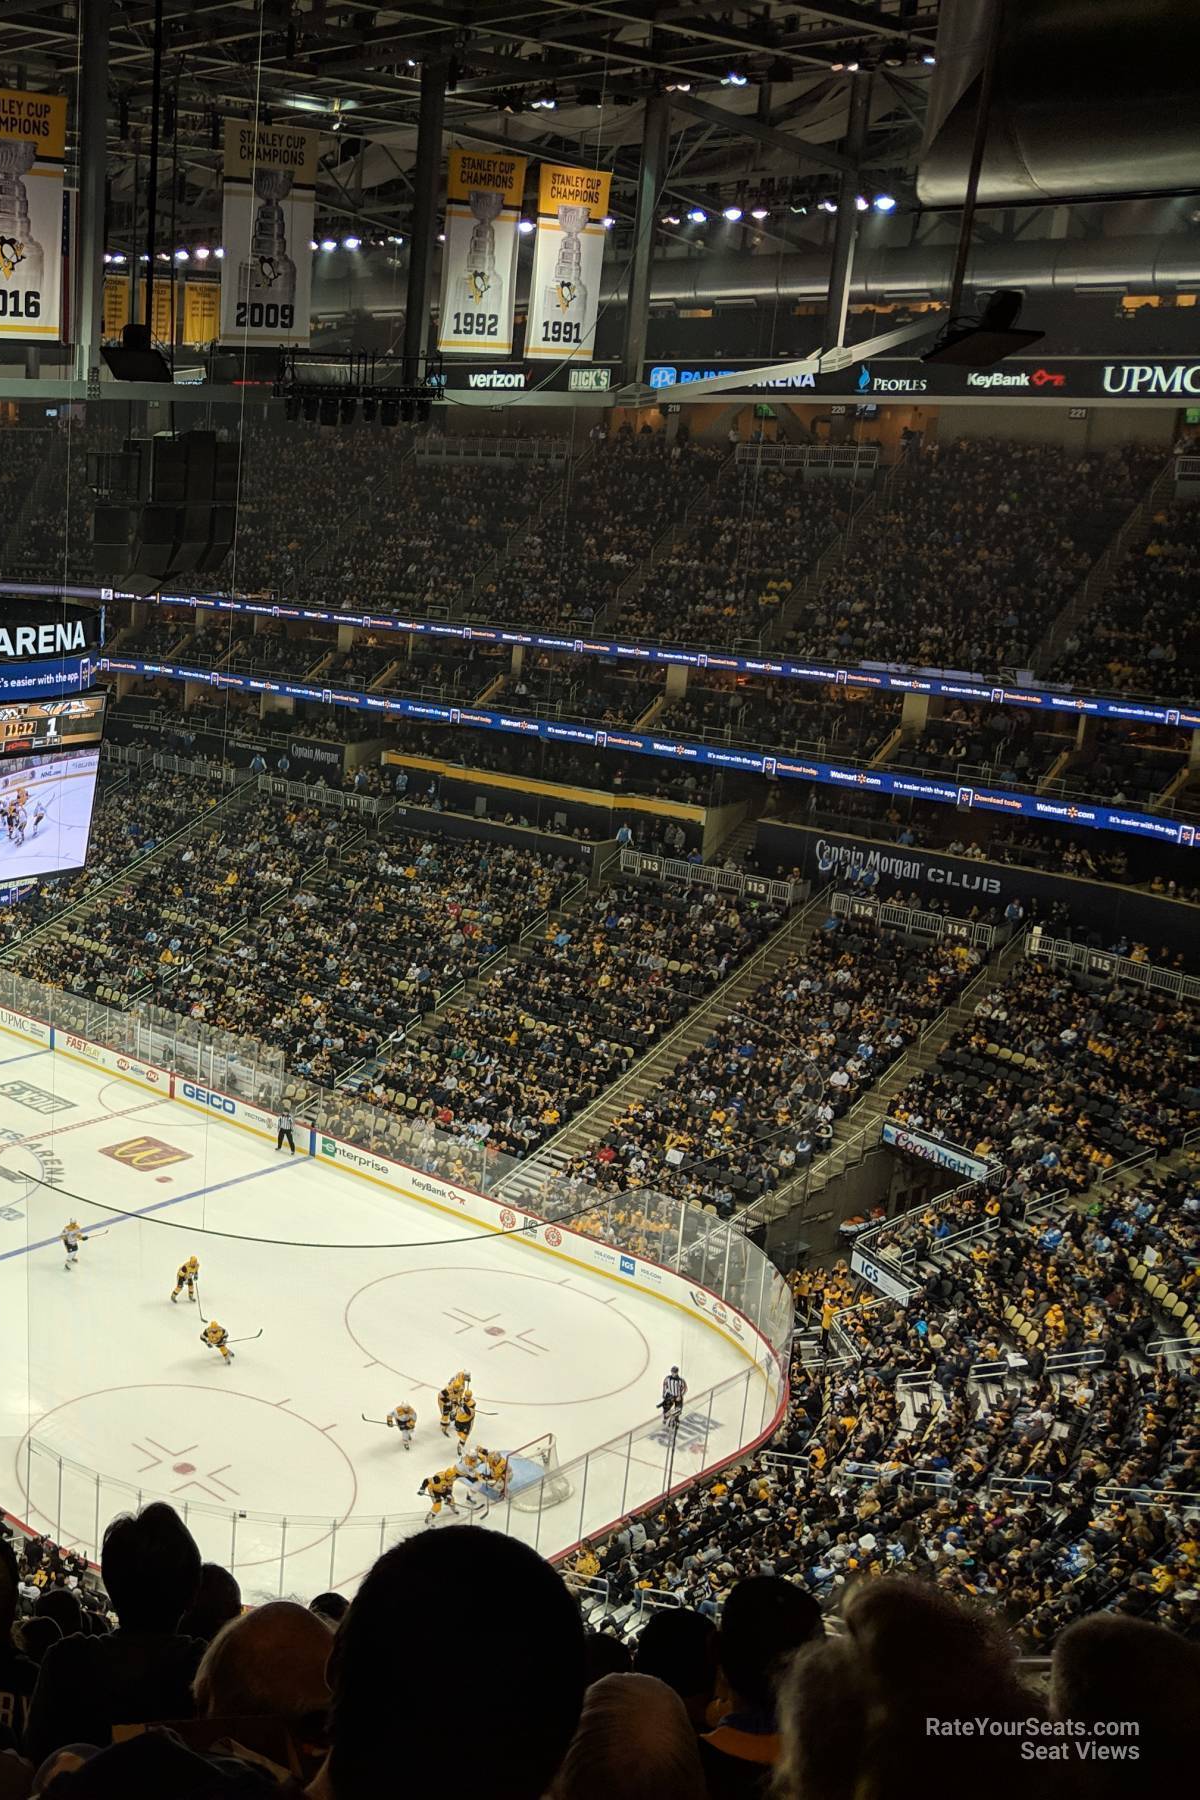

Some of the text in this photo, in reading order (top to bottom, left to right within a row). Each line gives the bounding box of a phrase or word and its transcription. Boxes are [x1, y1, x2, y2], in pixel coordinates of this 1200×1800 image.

[27, 102, 52, 119] CUP
[240, 129, 306, 150] STANLEY CUP
[240, 145, 305, 166] CHAMPIONS
[461, 157, 516, 175] STANLEY CUP
[460, 171, 515, 190] CHAMPIONS
[552, 173, 602, 191] STANLEY CUP
[551, 187, 600, 204] CHAMPIONS
[236, 302, 295, 329] 2009
[452, 312, 499, 336] 1992
[542, 320, 582, 344] 1991
[469, 370, 525, 388] verizon
[570, 370, 610, 388] DICK'S
[873, 377, 928, 392] PEOPLES
[967, 372, 1030, 388] KeyBank
[1103, 365, 1200, 393] UPMC
[831, 405, 846, 415] 220
[1069, 408, 1086, 418] 221
[10, 676, 36, 687] easier
[37, 674, 55, 685] with
[55, 673, 67, 683] the
[8, 722, 34, 736] 11:12
[47, 718, 58, 737] 1
[292, 743, 339, 763] Captain Morgan
[653, 743, 676, 753] Walmart
[210, 770, 222, 779] 110
[830, 770, 857, 781] Walmart
[274, 783, 285, 792] 111
[975, 794, 1003, 805] Download
[1036, 803, 1095, 820] Walmart com
[641, 859, 659, 872] 113
[868, 850, 921, 880] Morgan
[927, 868, 1000, 893] CLUB
[747, 881, 765, 895] 113
[854, 904, 873, 917] 114
[947, 924, 967, 938] 114
[1091, 957, 1111, 971] 115
[0, 1011, 29, 1031] UPMC
[118, 1060, 129, 1070] DQ
[148, 1071, 158, 1081] DQ
[0, 1081, 61, 1112] DICK'S
[182, 1083, 236, 1115] GEICO
[244, 1111, 266, 1124] VECTOR
[322, 1141, 389, 1175] enterprise
[895, 1129, 975, 1178] Coors LIGHT
[24, 1142, 65, 1185] ARENA
[411, 1176, 447, 1198] KeyBank
[621, 1260, 634, 1271] IGS
[860, 1260, 879, 1283] IGS
